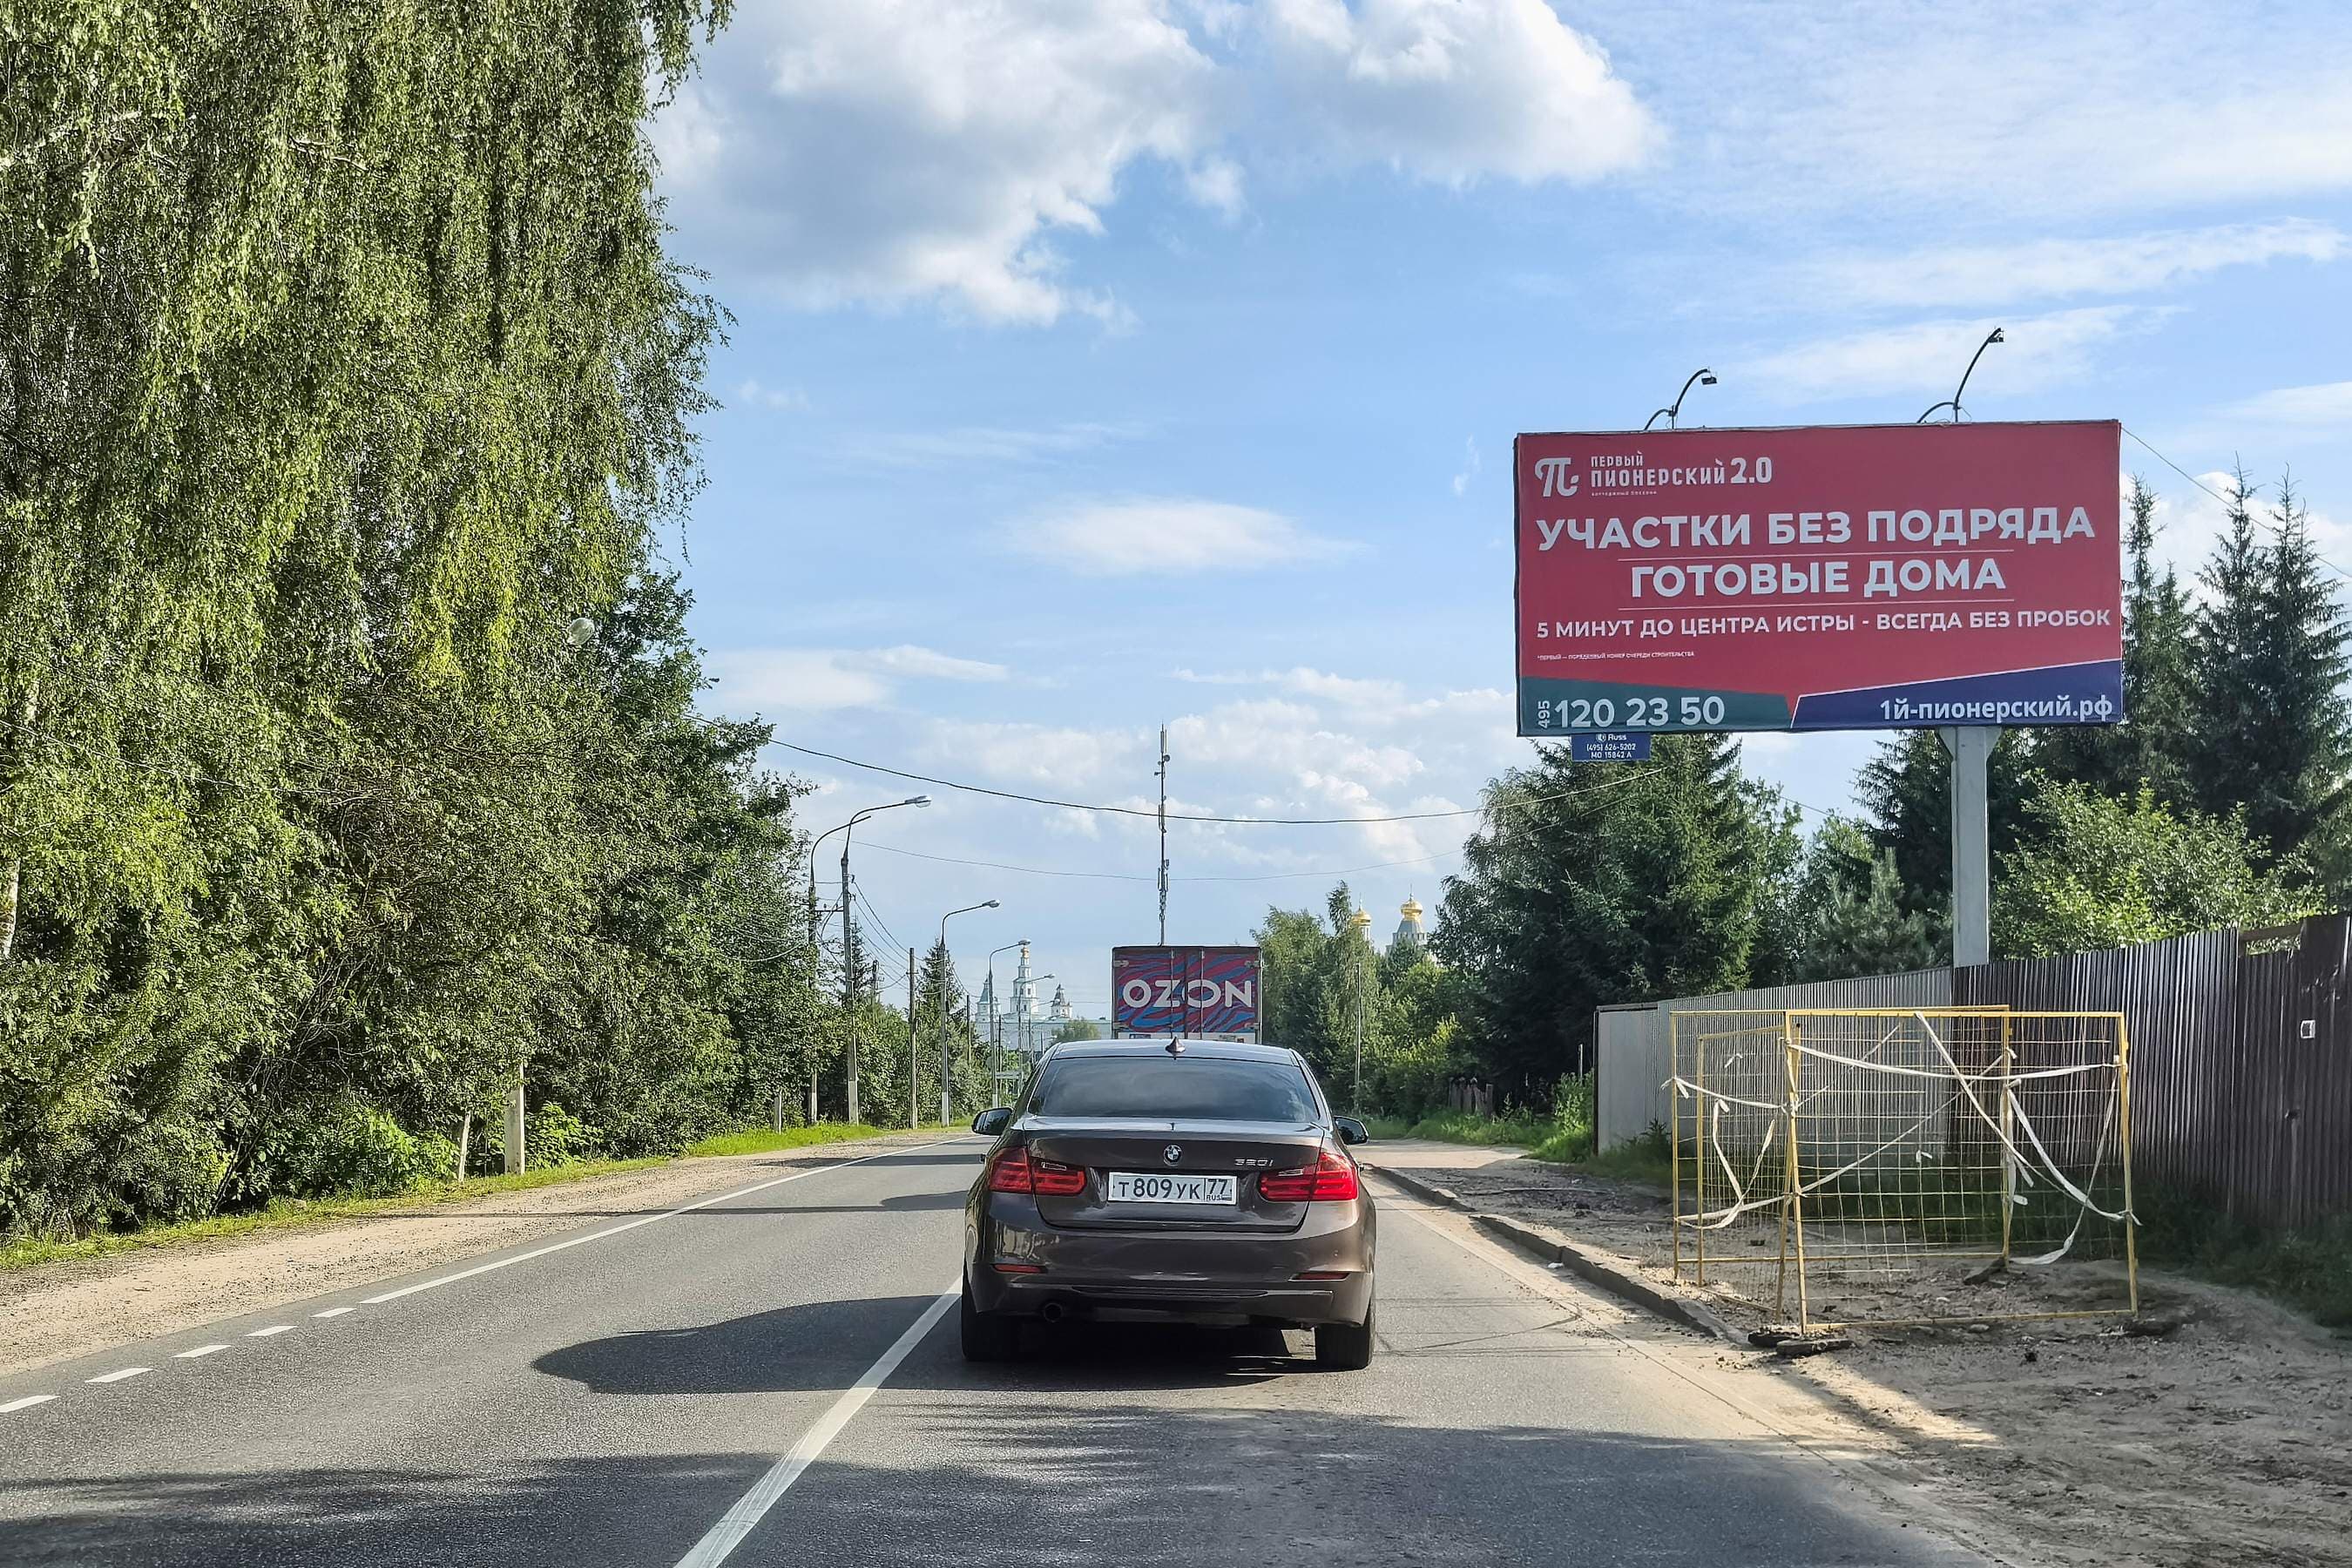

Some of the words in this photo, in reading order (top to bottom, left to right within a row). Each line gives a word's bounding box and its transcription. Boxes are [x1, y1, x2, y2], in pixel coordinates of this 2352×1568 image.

[1591, 450, 1644, 468] ПЕРВЫЙ
[1591, 458, 1726, 488] ПИОНЕРСКИЙ
[1730, 456, 1773, 484] 2.0
[1536, 514, 1750, 551] УЧАСТКИ
[1768, 511, 1851, 544] БЕЗ
[1868, 506, 2095, 546] ПОДРЯДА
[1632, 562, 1849, 598] ГОТОВЫЕ
[1863, 558, 2006, 598] ДОМА
[1537, 621, 1549, 639] 5
[1556, 619, 1634, 638] МИНУТ
[1639, 618, 1674, 639] ДО
[1680, 617, 1770, 638] ЦЕНТРА
[1776, 614, 1854, 633] ИСТРЫ
[1876, 612, 1963, 632] ВСЕГДА
[1970, 612, 2011, 628] БЕЗ
[2017, 610, 2111, 627] ПРОБОК
[1538, 700, 1551, 729] 495
[1555, 698, 1615, 728] 120
[1625, 697, 1669, 727] 23
[1680, 695, 1725, 726] 50
[1880, 694, 2112, 723] 1й-пионерский.рф
[1122, 978, 1253, 1009] OZON
[1207, 1178, 1228, 1195] 77
